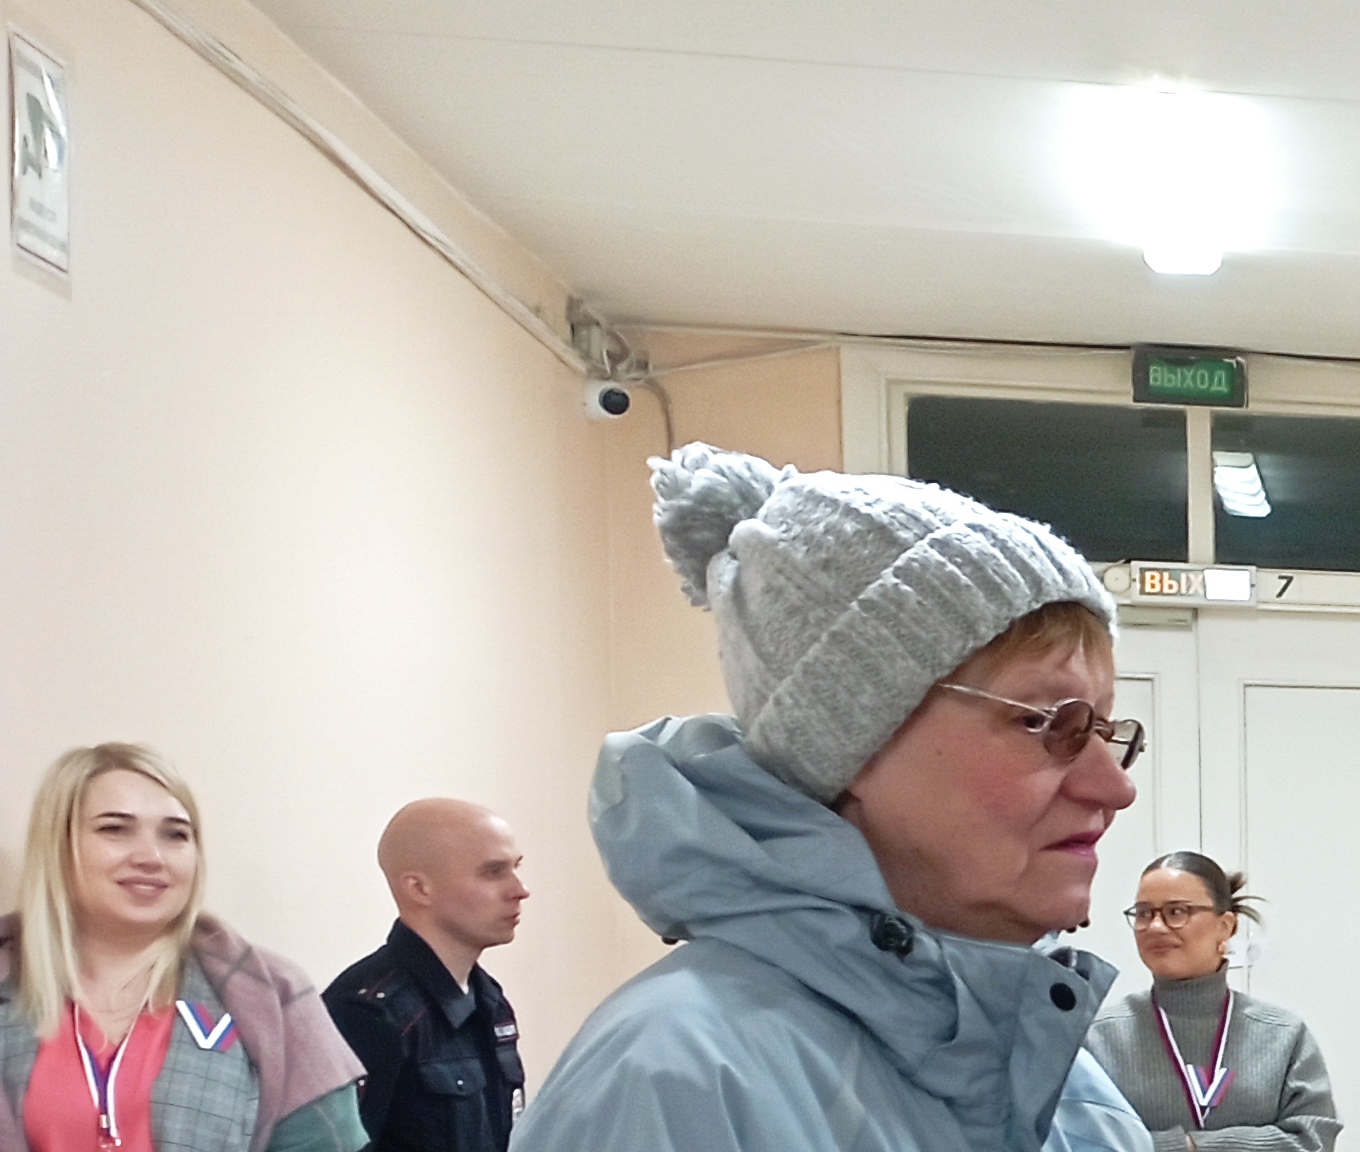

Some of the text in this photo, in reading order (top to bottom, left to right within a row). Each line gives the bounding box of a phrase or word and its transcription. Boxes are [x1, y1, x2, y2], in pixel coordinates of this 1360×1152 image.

[1149, 366, 1227, 392] ВЫХОД
[1144, 570, 1206, 595] ВЫХ
[1276, 574, 1295, 598] 7
